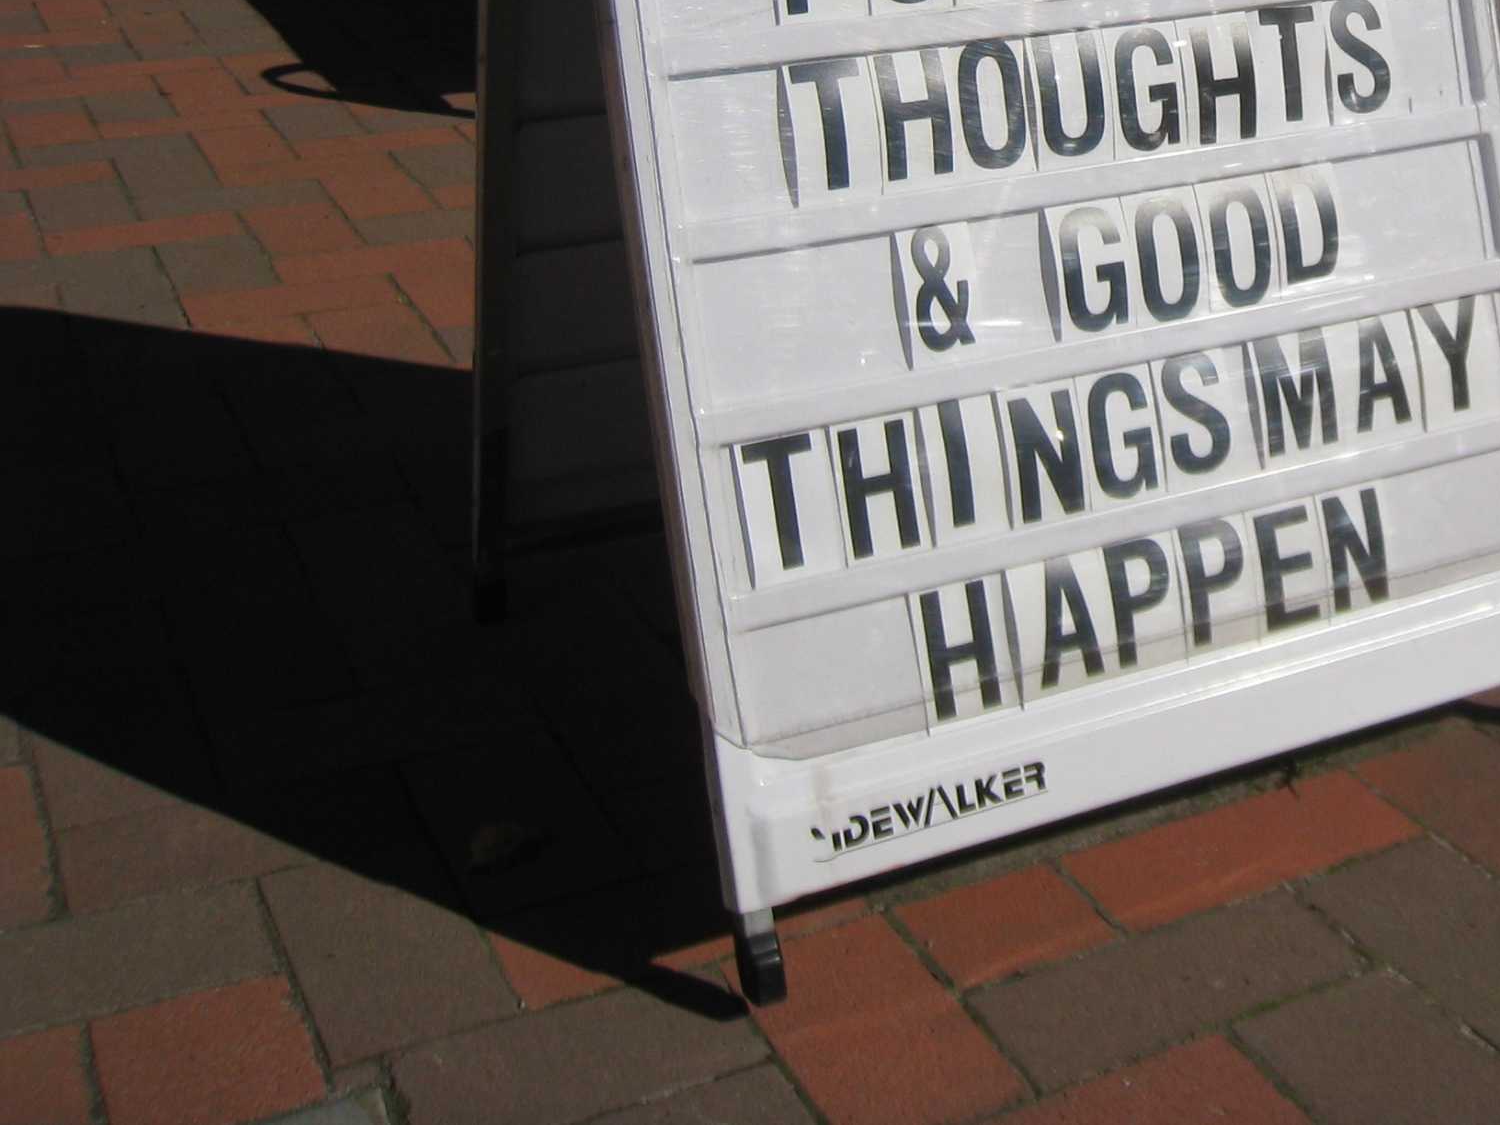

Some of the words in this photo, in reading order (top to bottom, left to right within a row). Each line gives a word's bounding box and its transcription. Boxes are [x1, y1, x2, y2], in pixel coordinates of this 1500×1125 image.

[910, 226, 975, 353] &
[1058, 172, 1340, 333] GOOD
[742, 352, 1233, 571] THINGS
[1250, 295, 1478, 458] MAY
[918, 487, 1391, 722] HAPPEN
